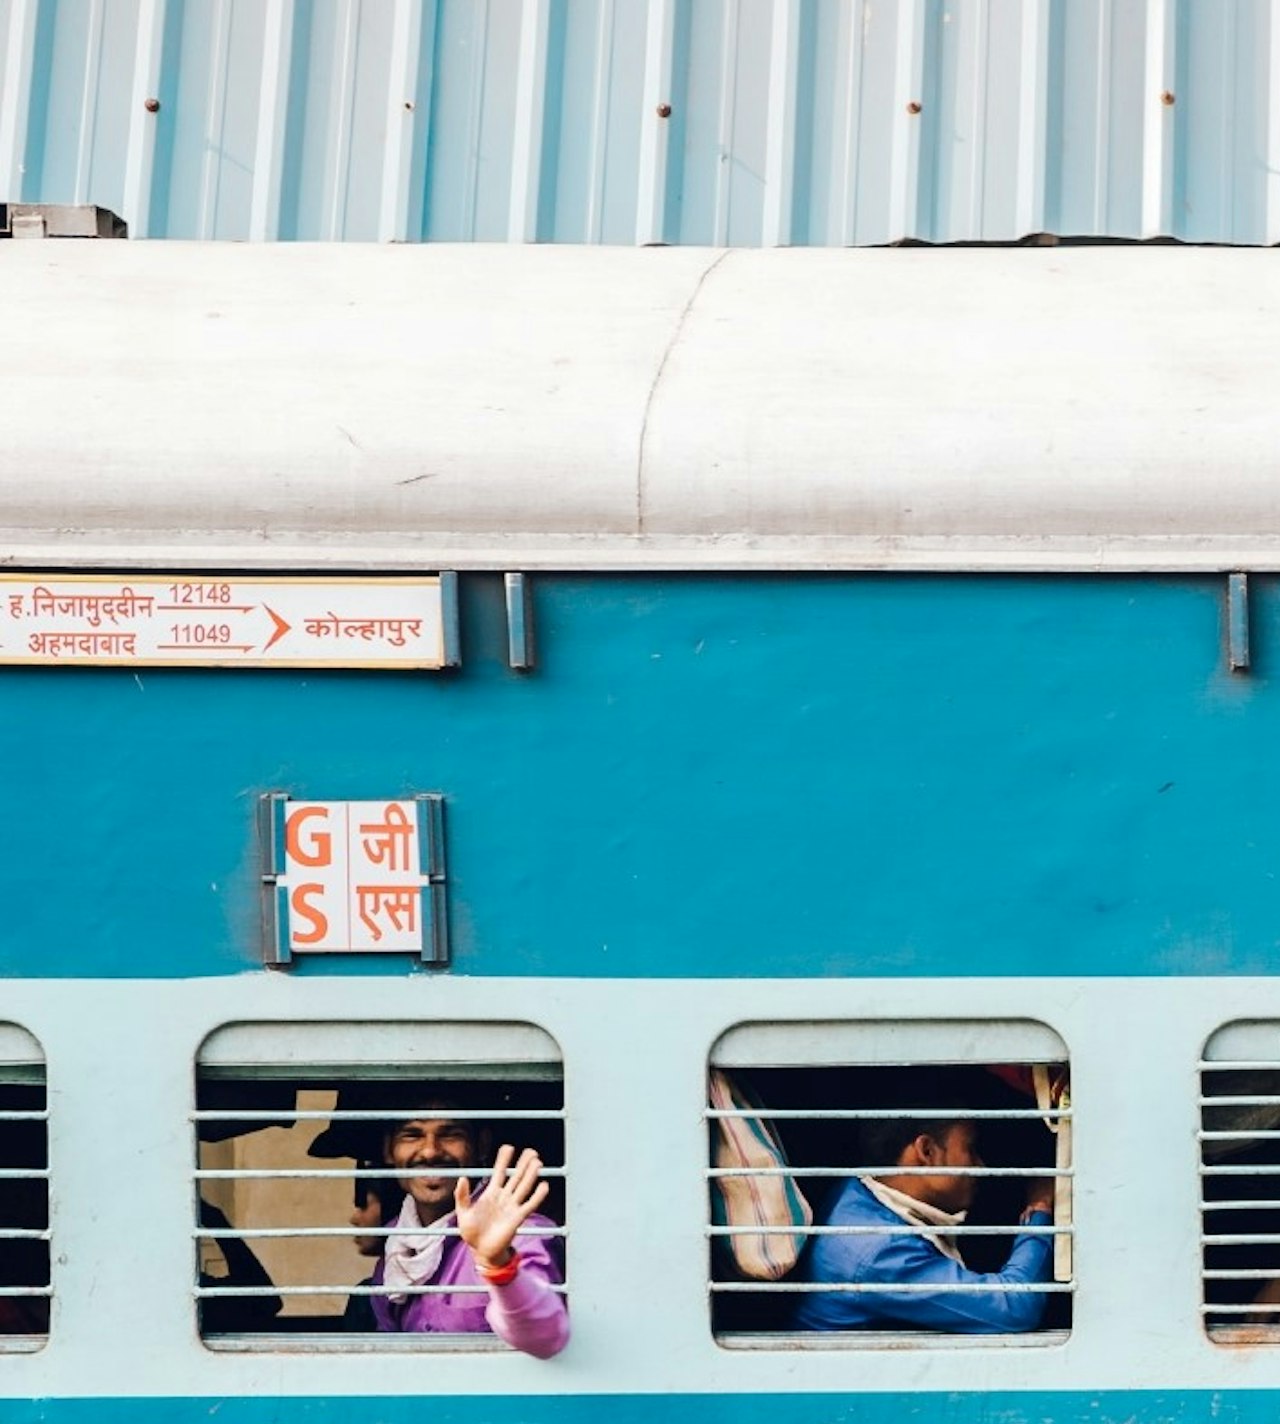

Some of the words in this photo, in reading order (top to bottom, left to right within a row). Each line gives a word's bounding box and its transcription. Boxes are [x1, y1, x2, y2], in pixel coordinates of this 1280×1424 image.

[169, 583, 232, 603] 12148
[28, 632, 136, 657] अहमदाबाद
[170, 624, 231, 643] 11049
[304, 611, 423, 647] कोल्हापुर
[285, 806, 333, 868] G
[359, 803, 415, 872] जी
[292, 882, 330, 945] S
[356, 886, 420, 941] एस
